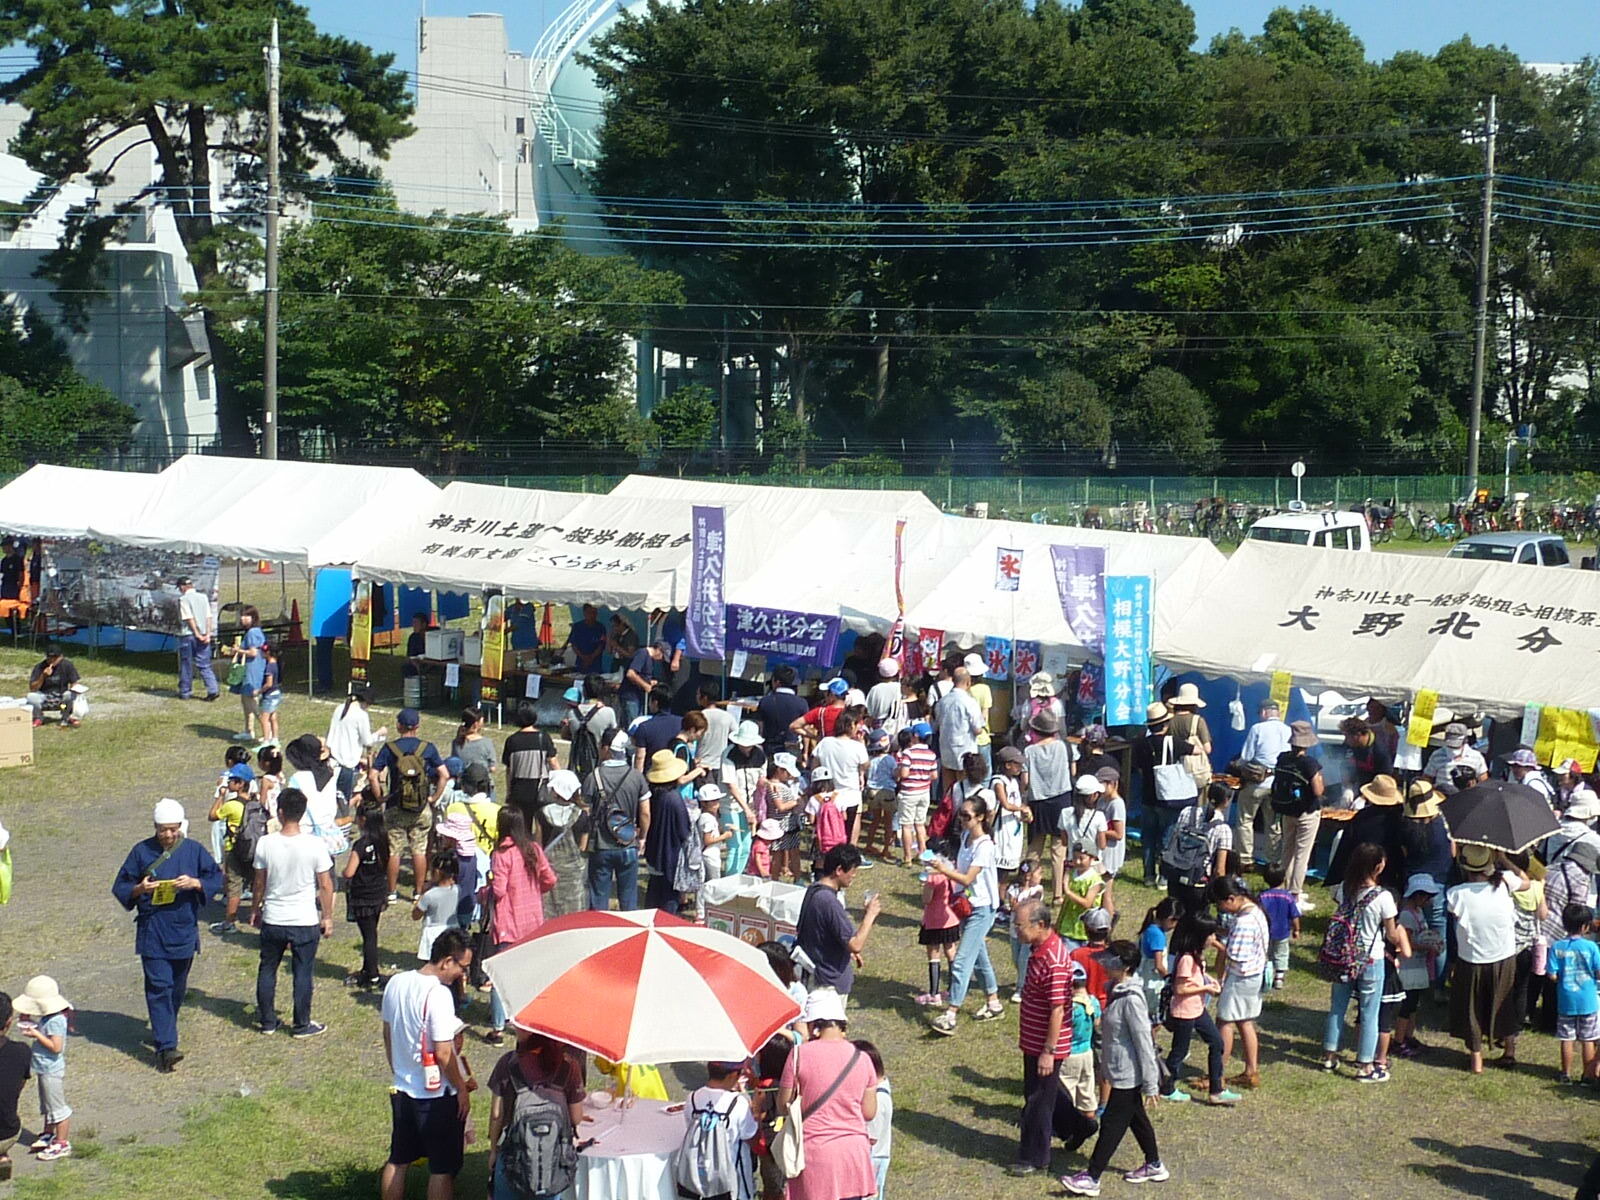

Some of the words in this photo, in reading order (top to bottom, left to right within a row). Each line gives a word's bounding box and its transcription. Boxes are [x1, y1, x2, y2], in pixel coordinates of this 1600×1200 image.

[999, 554, 1021, 578] 氷
[736, 607, 828, 641] 津久井分会
[1314, 585, 1600, 628] 神奈川土建一般労働組合相模原
[1278, 606, 1600, 654] 大野北分
[987, 650, 1007, 674] 氷
[1112, 598, 1134, 721] 相模大野分会
